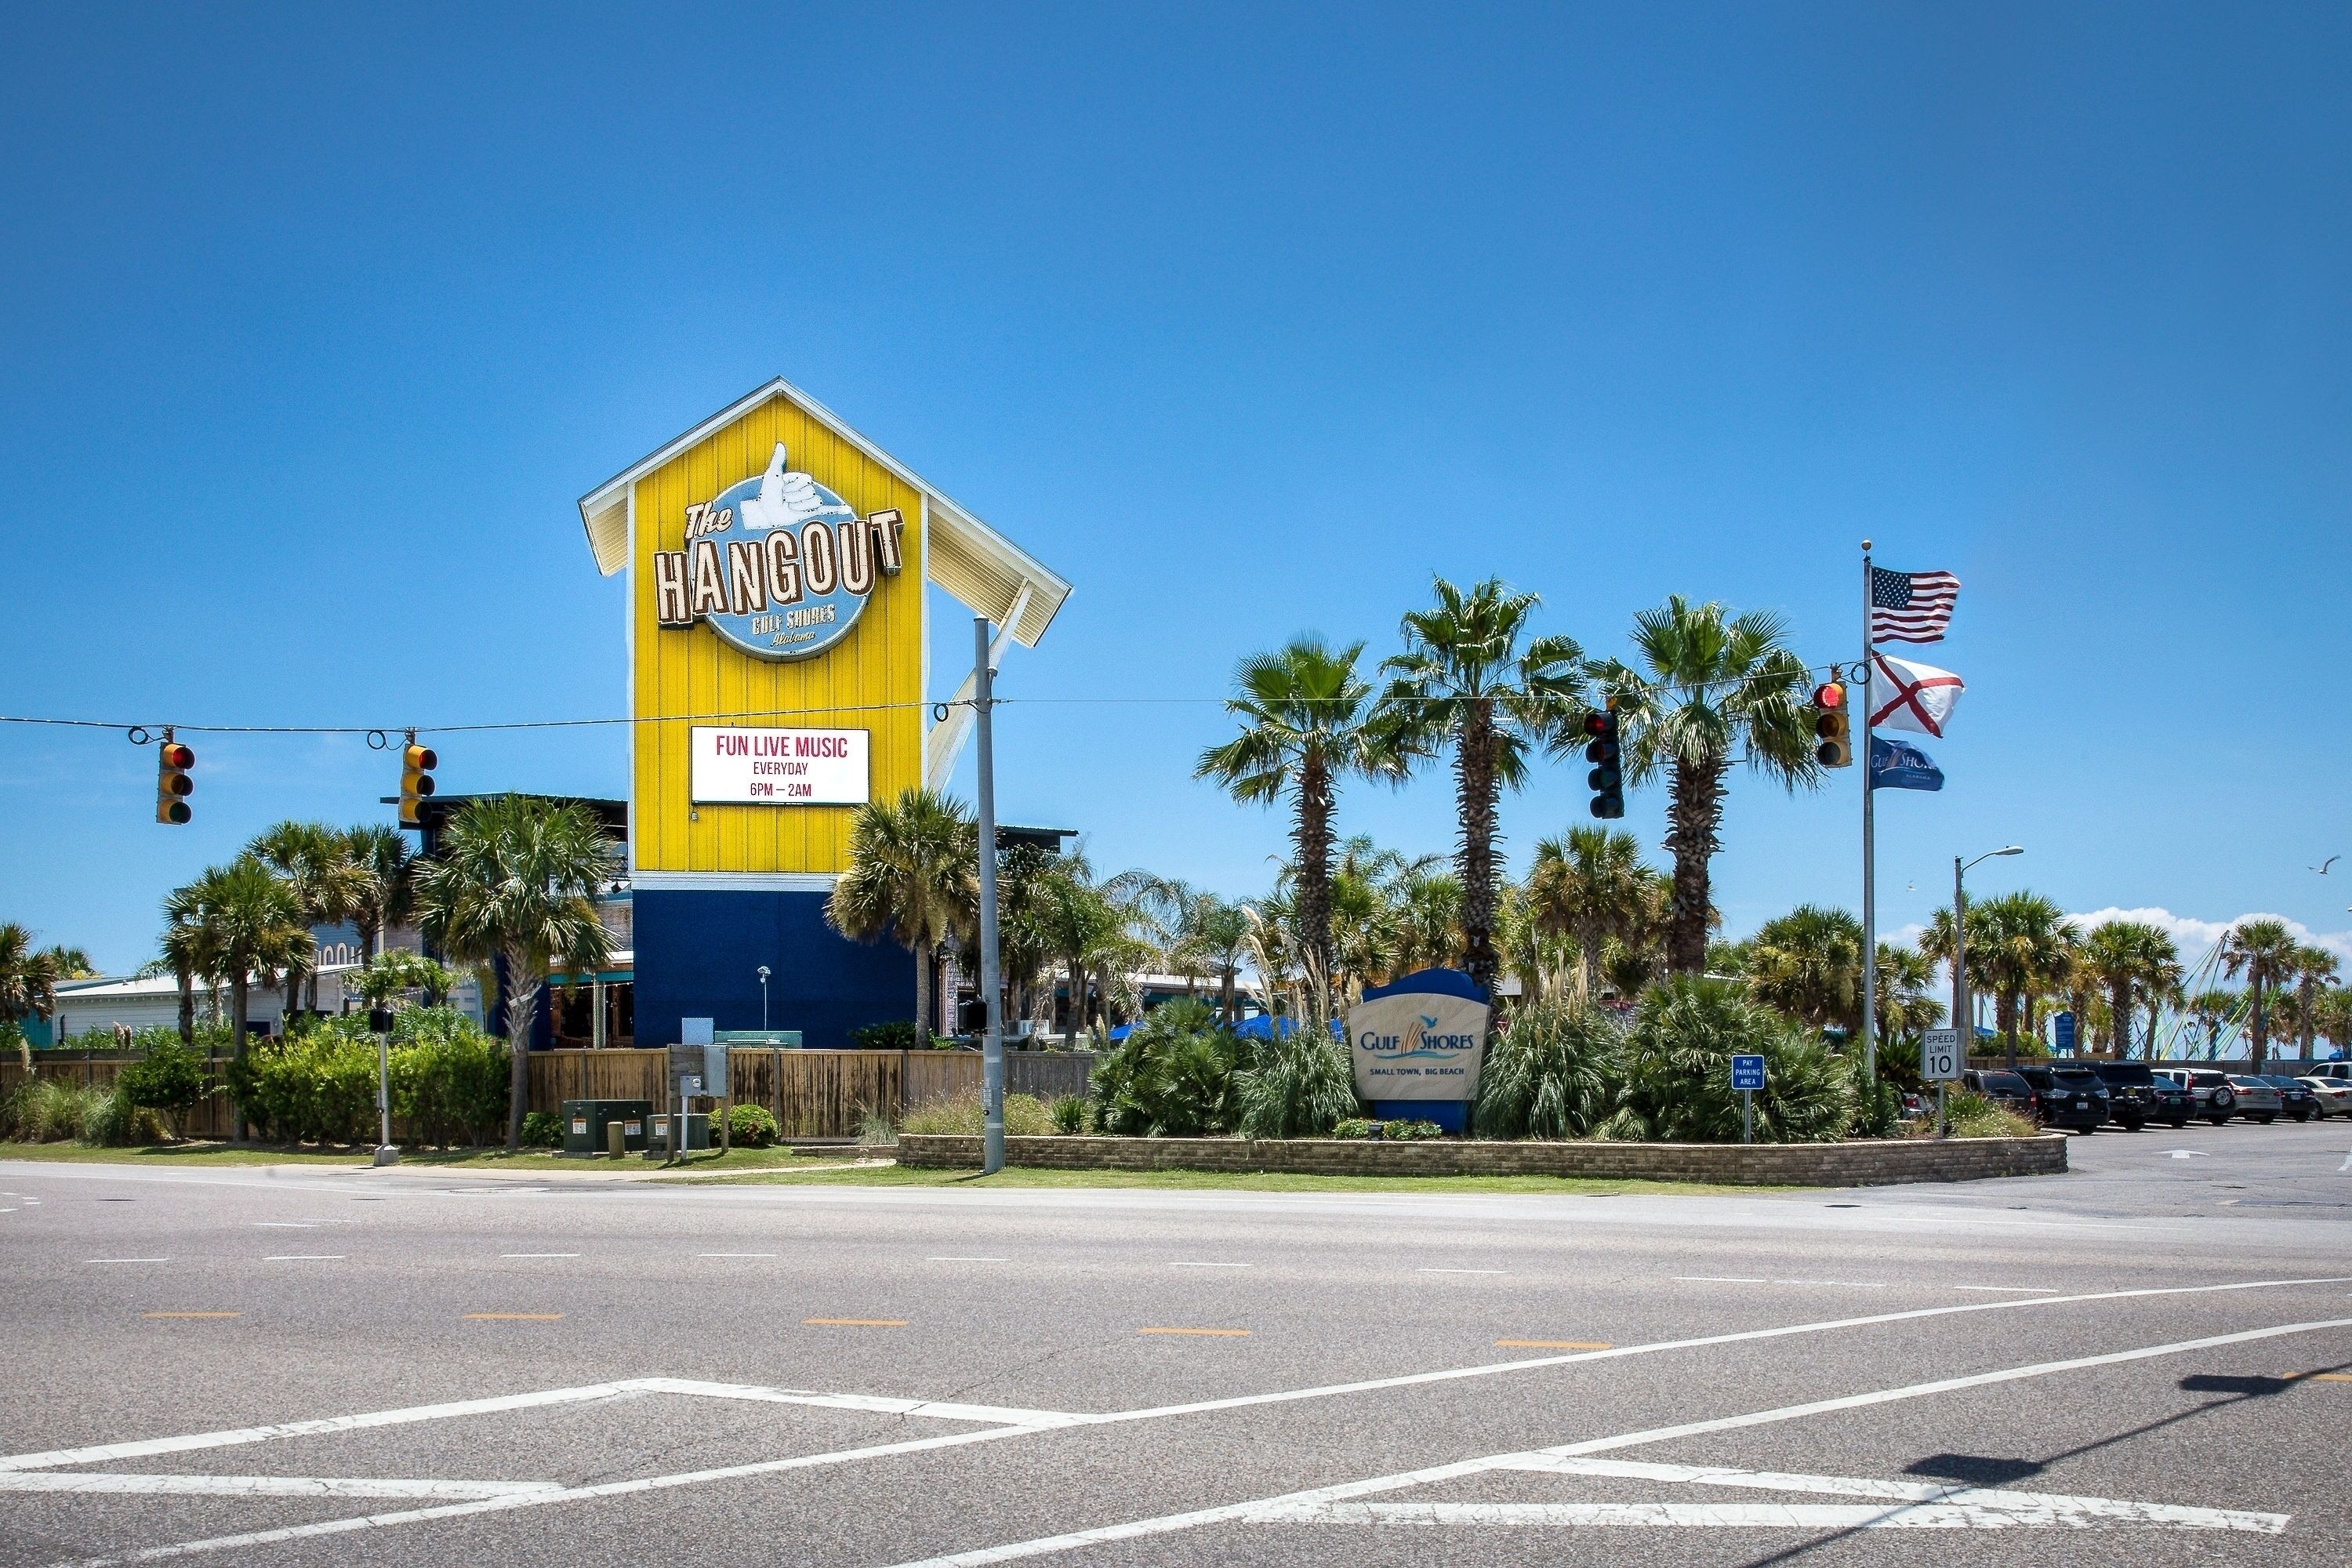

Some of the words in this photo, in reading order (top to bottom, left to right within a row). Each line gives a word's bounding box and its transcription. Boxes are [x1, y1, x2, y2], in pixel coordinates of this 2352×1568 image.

[684, 502, 733, 539] The
[654, 509, 904, 625] HANGOUT
[753, 613, 783, 636] GULF
[786, 604, 837, 630] SHORES
[770, 631, 816, 648] Alabama
[717, 735, 748, 756] FUN
[754, 736, 790, 757] LIVE
[796, 737, 848, 758] MUSIC
[753, 761, 808, 775] EVERYDAY
[750, 782, 773, 797] 6PM
[788, 783, 812, 797] 2AM
[1360, 1032, 1400, 1051] GULF
[1420, 1031, 1474, 1050] SHORES
[1926, 1035, 1955, 1044] SPEED
[1929, 1045, 1952, 1054] LIMIT
[1929, 1055, 1952, 1073] 10
